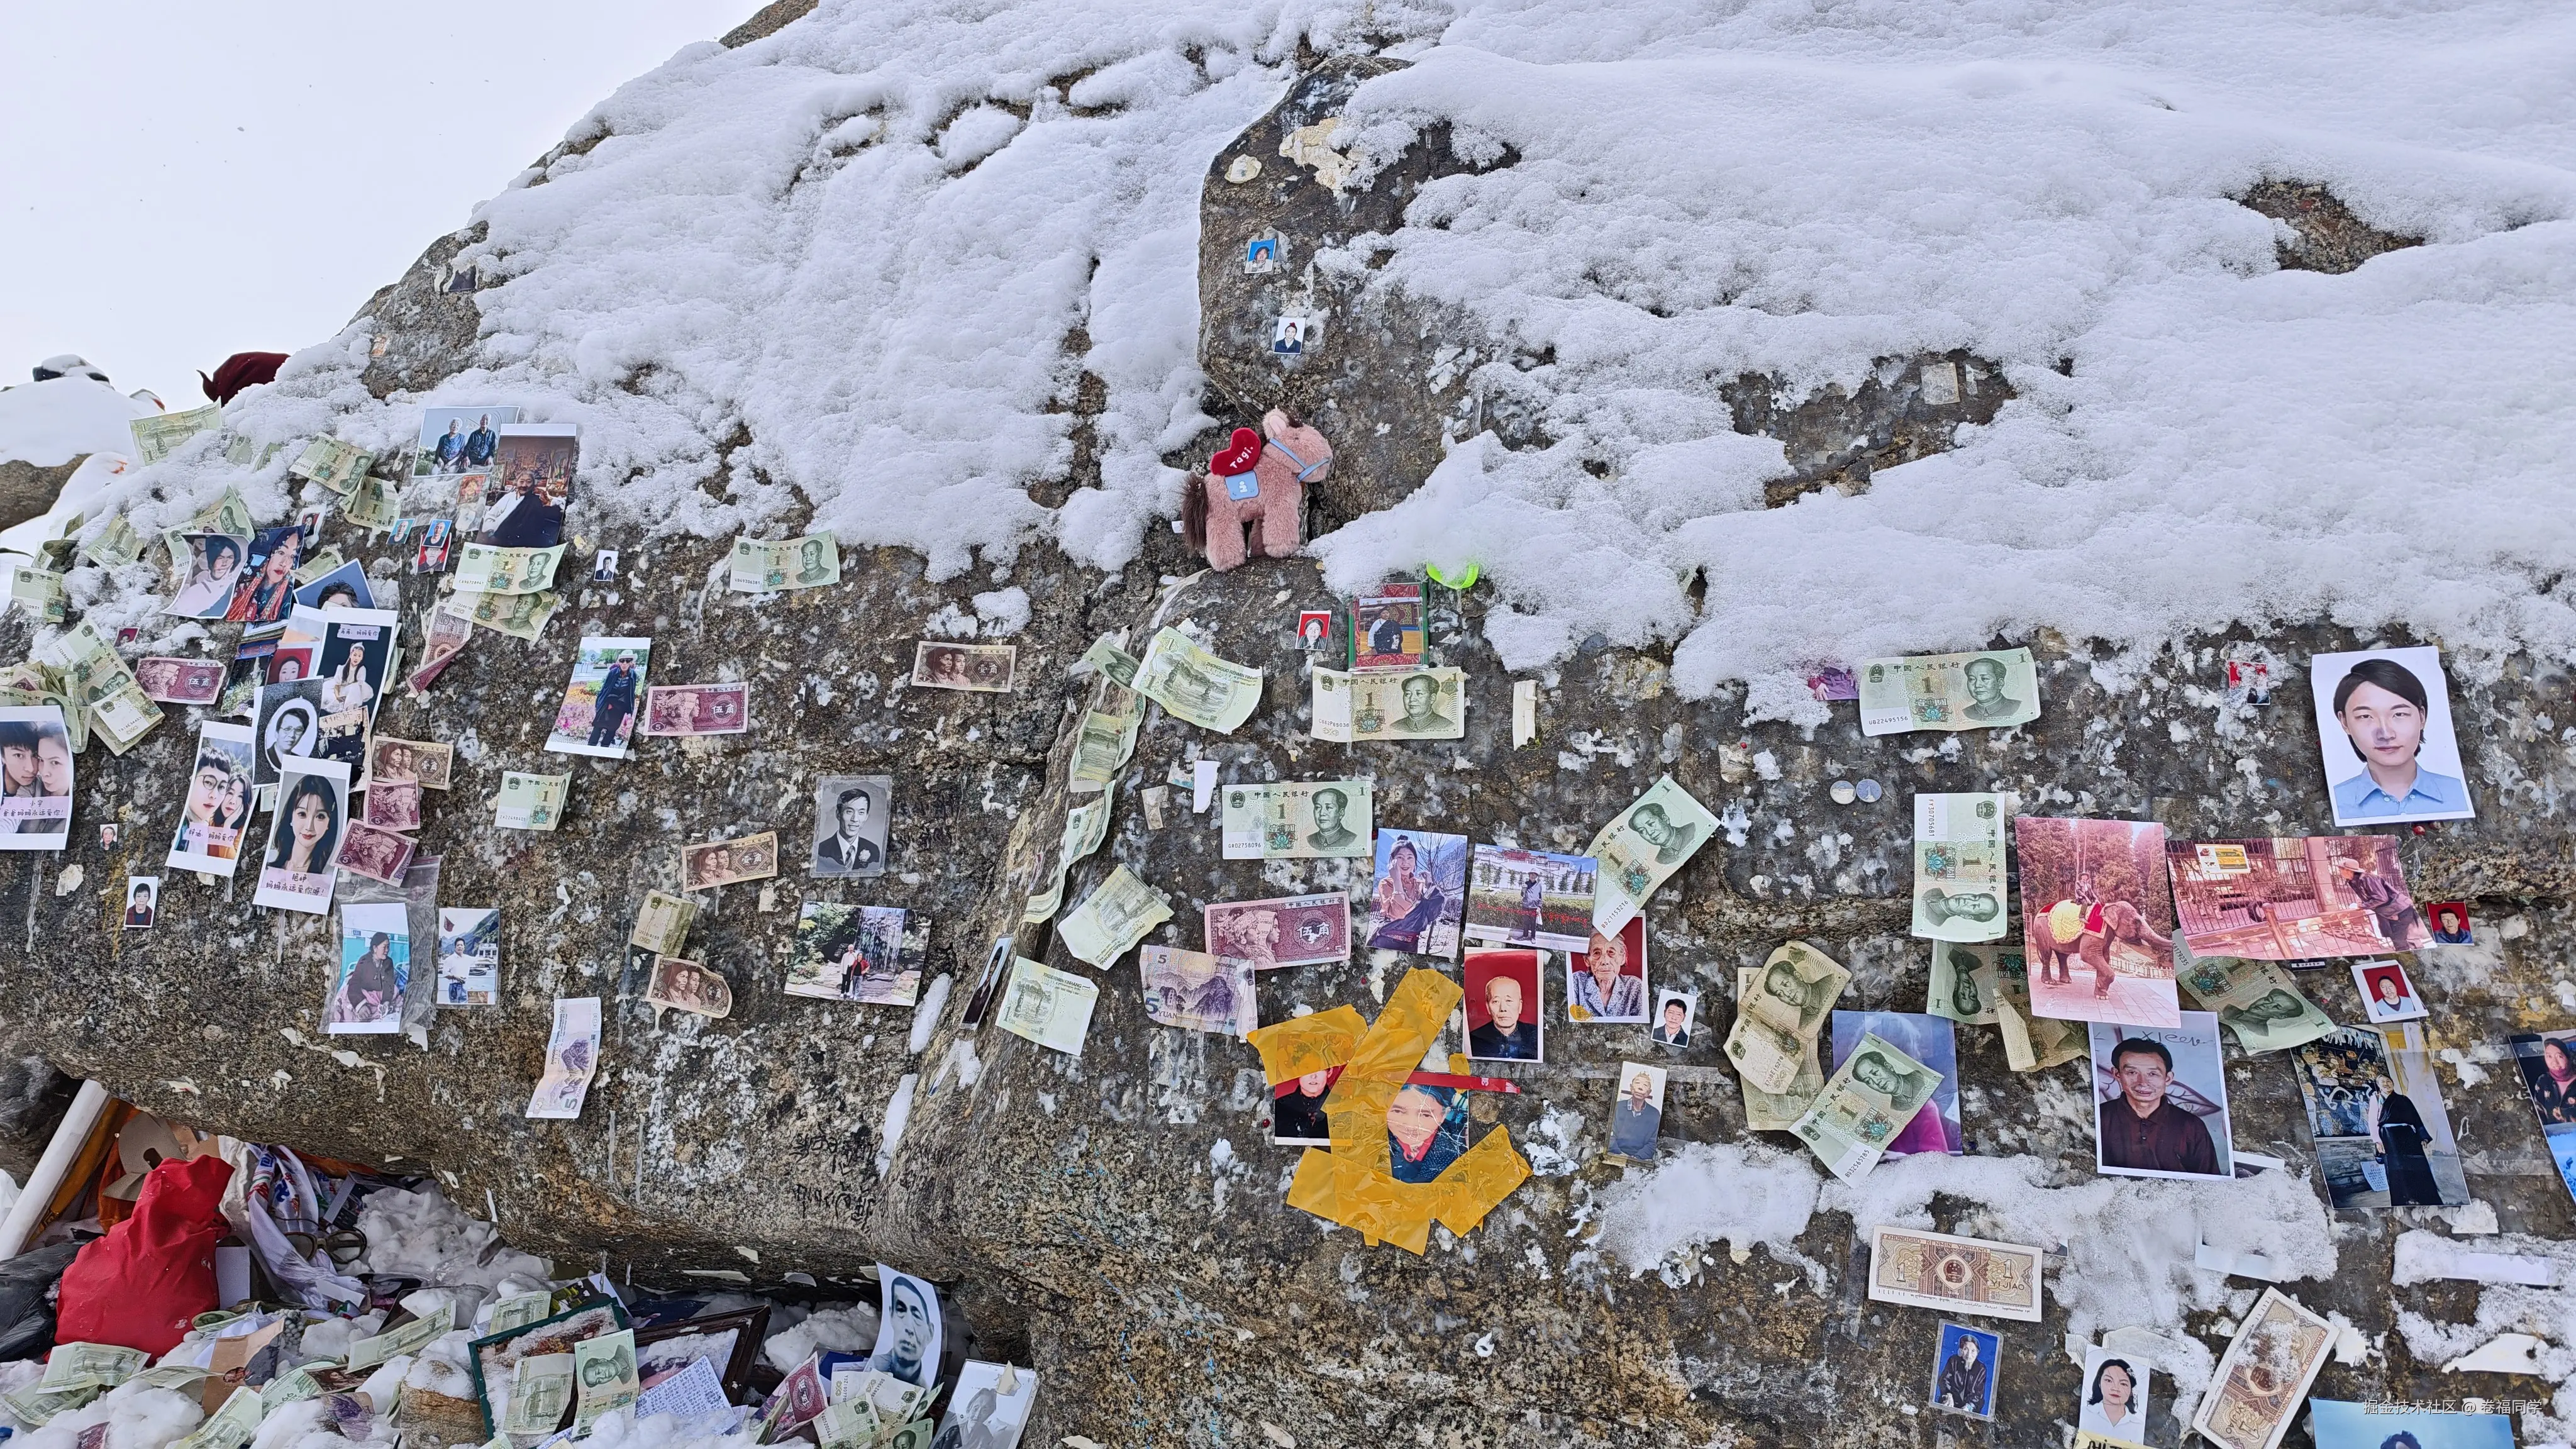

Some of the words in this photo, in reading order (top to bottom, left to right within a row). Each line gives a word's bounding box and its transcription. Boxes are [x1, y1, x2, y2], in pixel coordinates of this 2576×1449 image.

[1230, 447, 1253, 468] Tagi.
[487, 550, 529, 558] 中国人民银行
[2019, 653, 2026, 663] 1
[978, 664, 998, 674] 壹角
[1206, 662, 1230, 672] ZHONGGUO
[1894, 662, 1960, 673] 中国人民银行
[188, 677, 210, 687] 伍角
[1342, 677, 1398, 686] 中国人民银行
[1452, 673, 1457, 682] 1
[1922, 677, 1934, 694] 1
[1153, 688, 1168, 700] YUAN
[1365, 691, 1375, 707] 1
[711, 704, 735, 714] 伍角
[1868, 716, 1908, 725] UB22495156
[422, 761, 438, 770] 壹角
[542, 791, 548, 802] 1
[1254, 791, 1309, 799] 中国人民银行
[1359, 787, 1365, 796] 1
[3, 809, 64, 817] 爸爸妈妈永远爱你!
[1277, 803, 1286, 819] 1
[341, 856, 349, 864] 5
[741, 853, 762, 864] 壹角
[1962, 857, 1982, 868] 1
[1987, 829, 1997, 892] 中国人民银行
[266, 881, 325, 896] 妈妈永远爱你呀!
[1288, 899, 1336, 909] 中国人民银行
[1601, 900, 1629, 929] BD21153216
[1296, 923, 1330, 941] 伍角
[1158, 954, 1167, 963] 5
[707, 987, 721, 999] 壹角
[1145, 997, 1160, 1014] 5
[1158, 1010, 1177, 1019] YUAN
[564, 1099, 578, 1109] 5
[1811, 1077, 1851, 1126] 中国人民银行
[1838, 1104, 1858, 1120] 1
[1844, 1149, 1870, 1179] BD32565785
[1885, 1235, 1921, 1244] ZHONGGUO
[1926, 1240, 1952, 1248] RENMIN
[1957, 1244, 1988, 1253] YINHANG
[1896, 1262, 1906, 1282] 1
[2002, 1258, 2013, 1279] 1
[2304, 1331, 2328, 1367] ZHONGGUO
[2272, 1396, 2292, 1426] YINHANG
